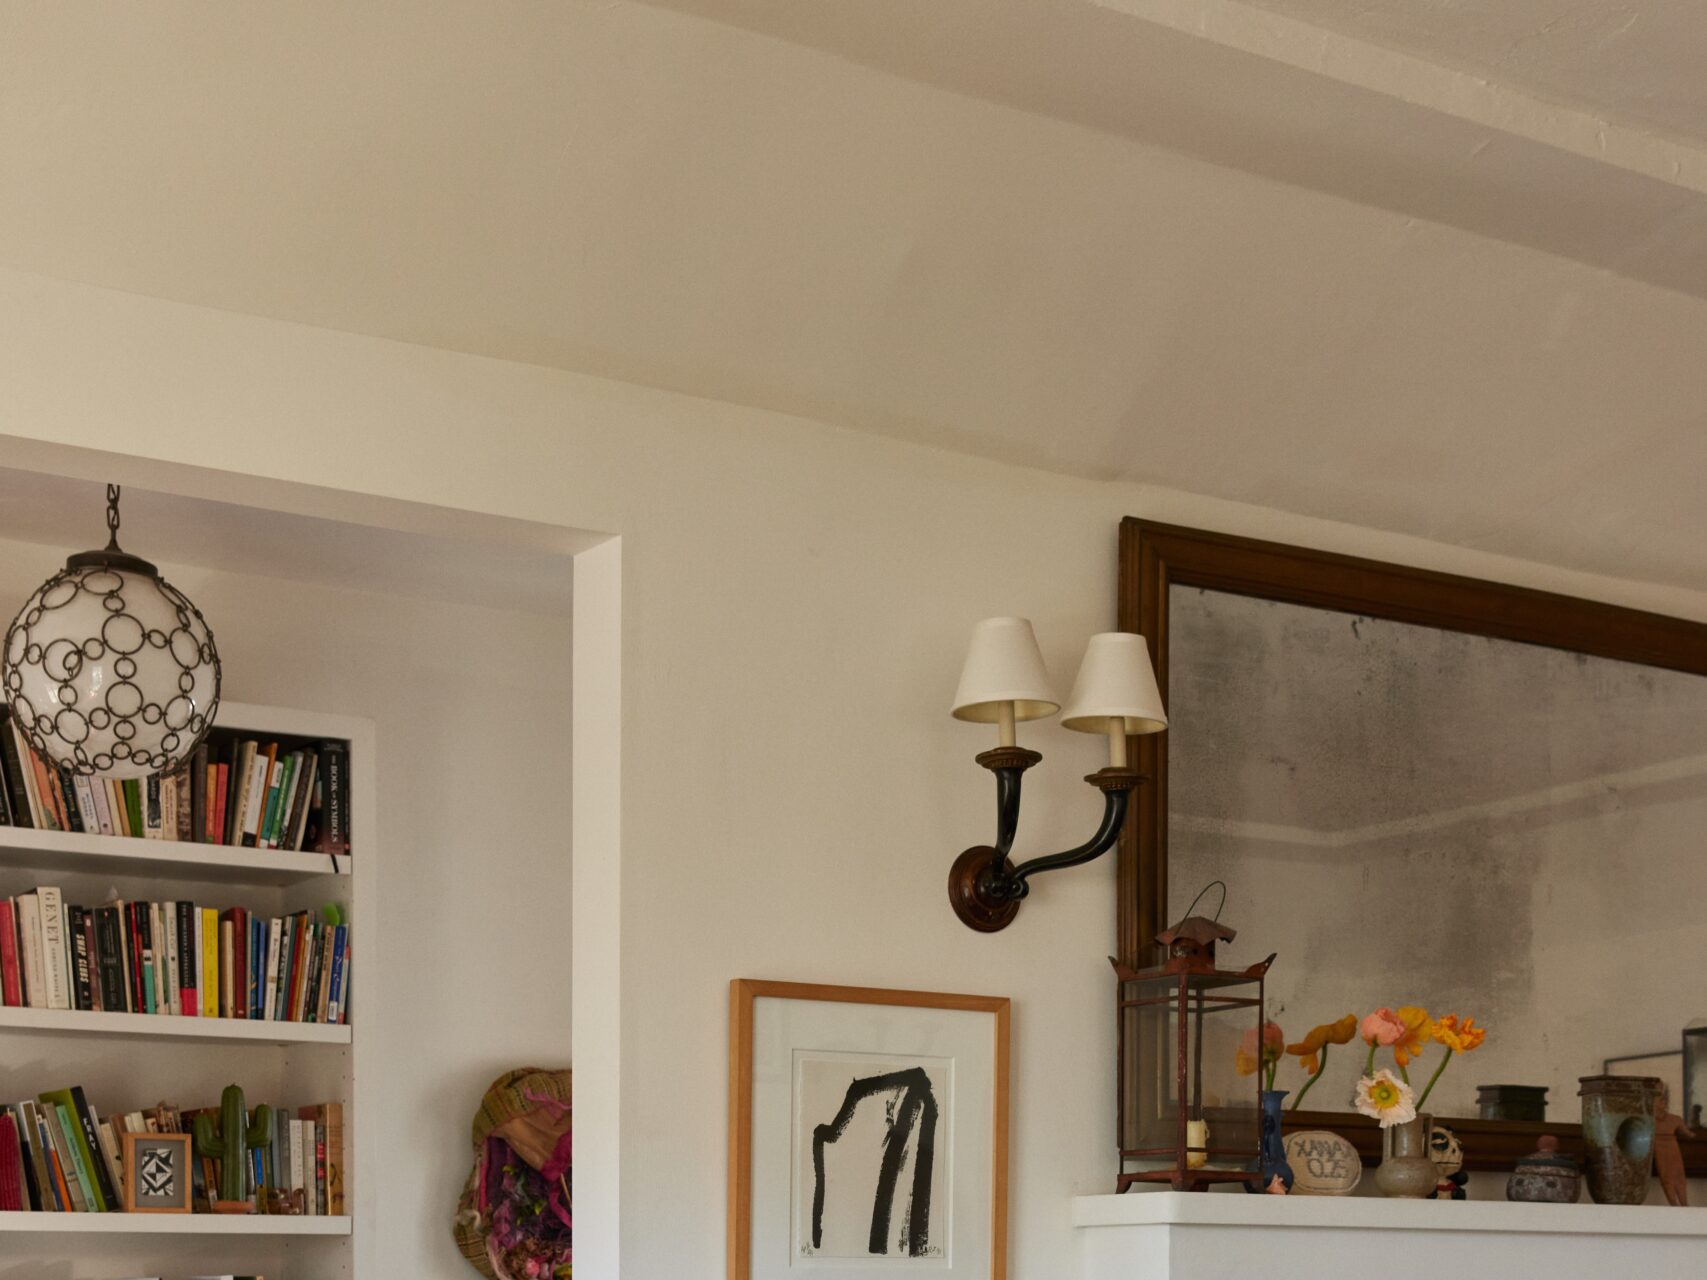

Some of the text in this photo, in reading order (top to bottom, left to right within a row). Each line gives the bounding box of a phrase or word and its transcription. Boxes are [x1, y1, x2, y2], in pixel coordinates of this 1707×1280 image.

[330, 765, 339, 792] BOOK
[330, 799, 339, 843] SYMBOLS
[44, 891, 59, 945] GENET
[75, 934, 89, 983] SWAP CLUBS
[83, 1117, 98, 1151] FRAY
